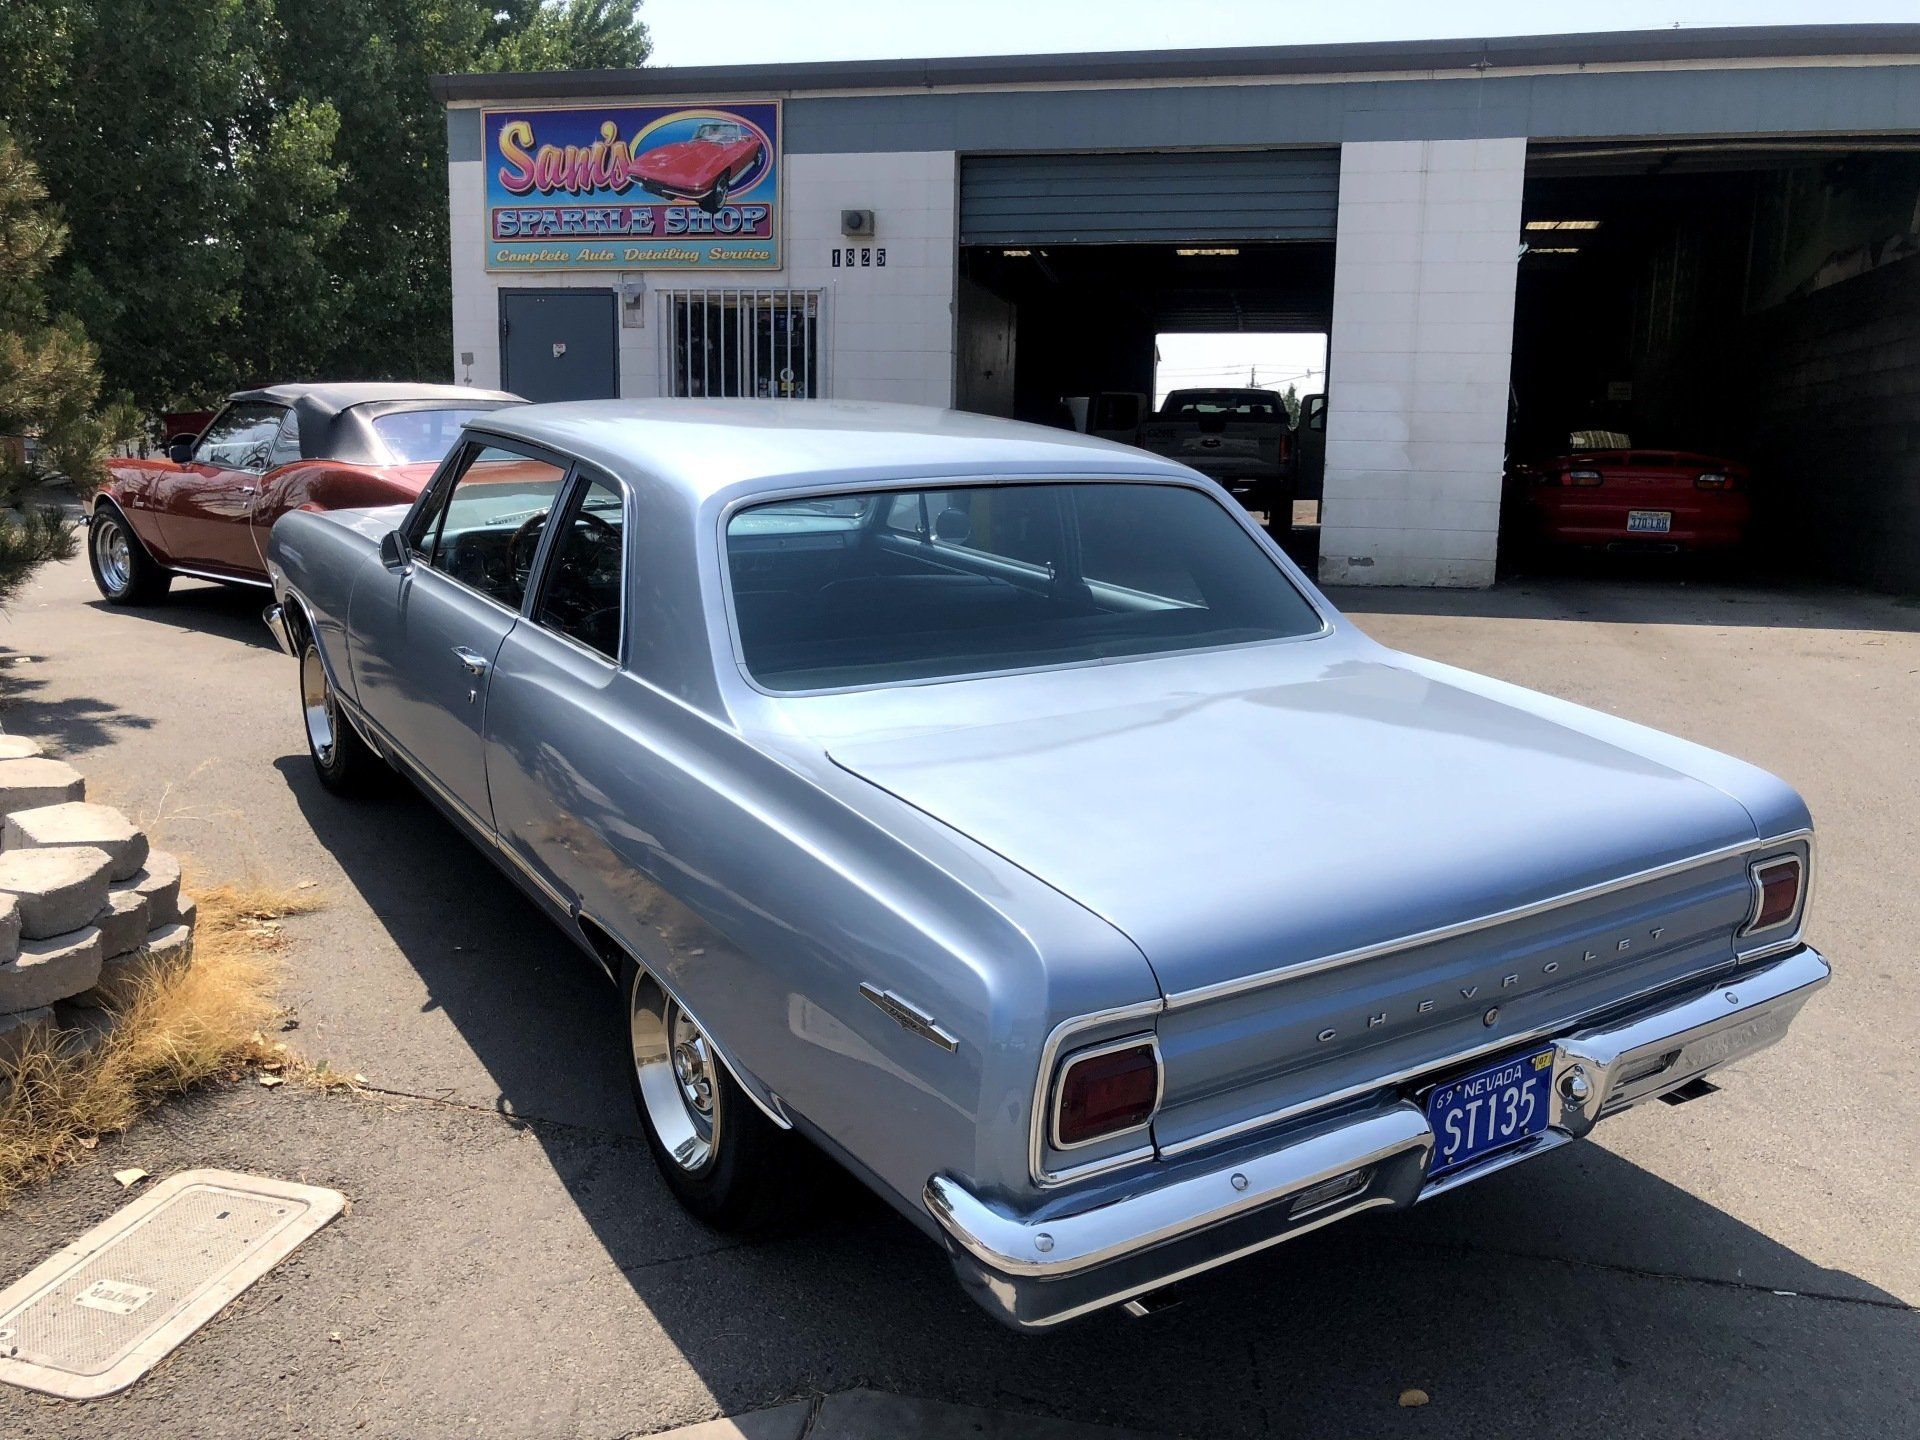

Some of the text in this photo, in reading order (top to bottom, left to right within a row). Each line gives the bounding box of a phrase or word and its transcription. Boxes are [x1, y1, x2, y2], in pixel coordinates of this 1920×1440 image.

[499, 120, 632, 192] Sam's
[497, 206, 767, 236] SPARKLE SHOP
[496, 248, 770, 265] Complete Auto Detailing Service
[832, 248, 886, 267] 1825
[1318, 927, 1664, 1042] CHEVROLET
[1437, 1065, 1522, 1109] 69 NEVADA
[1443, 1077, 1537, 1156] ST135
